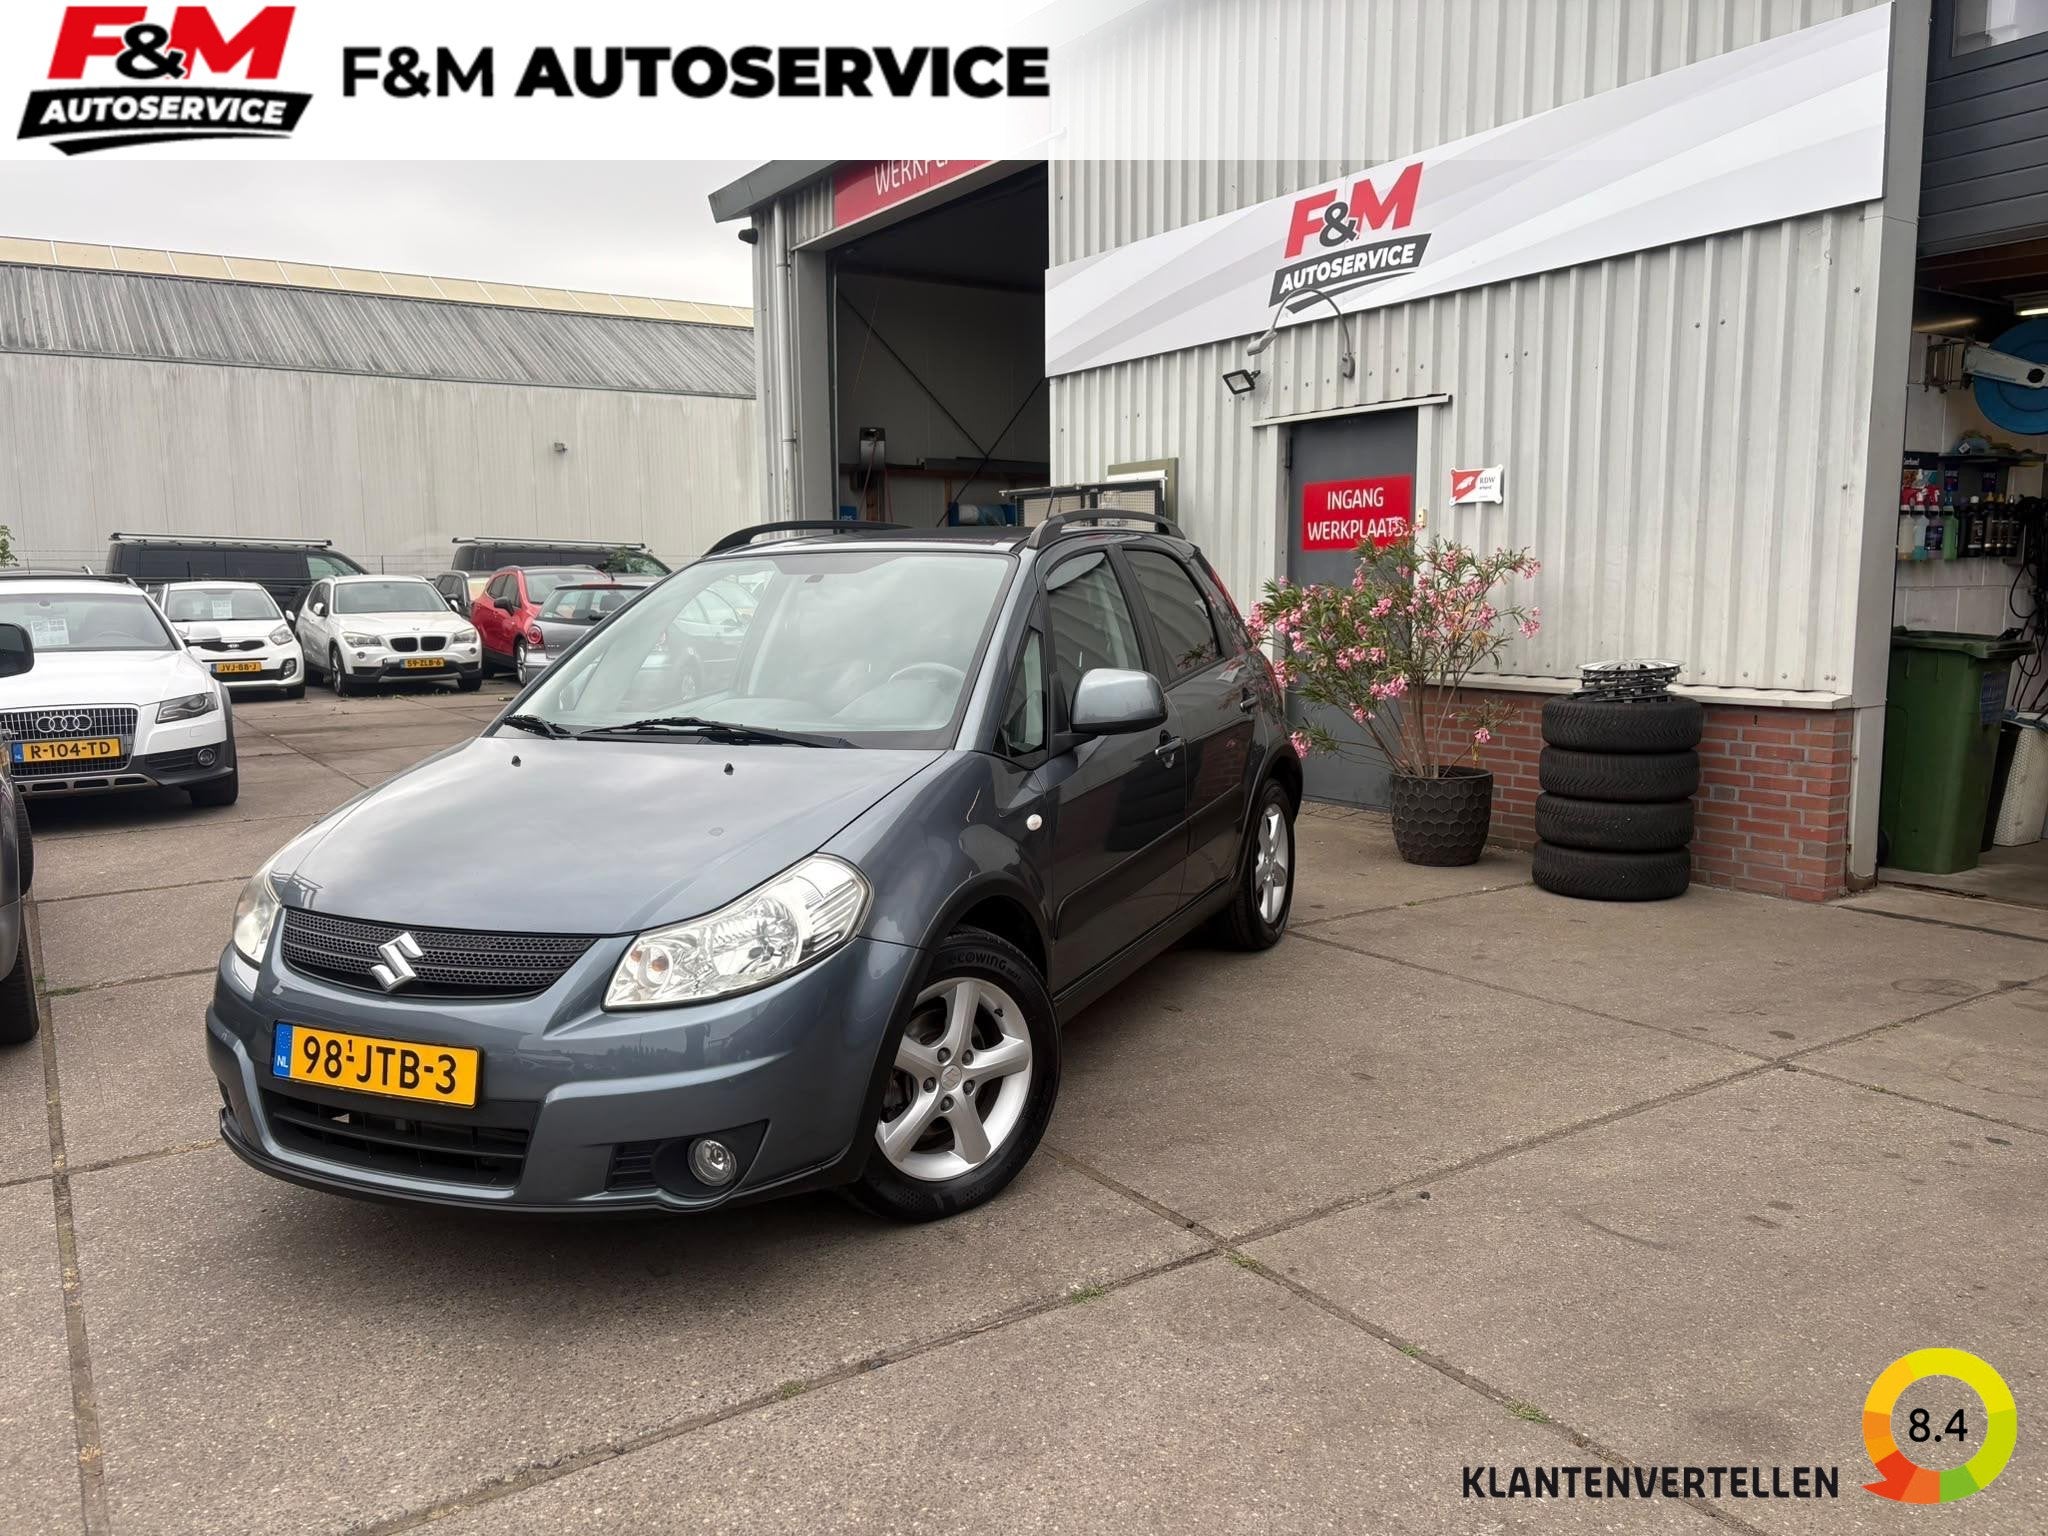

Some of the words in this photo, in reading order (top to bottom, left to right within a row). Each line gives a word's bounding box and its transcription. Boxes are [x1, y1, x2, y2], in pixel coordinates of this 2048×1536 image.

[1284, 161, 1424, 259] F&M
[1279, 242, 1416, 294] AUTOSERVICE
[1327, 487, 1384, 511] INGANG
[30, 741, 111, 760] R-104-TD
[276, 1055, 289, 1068] NL
